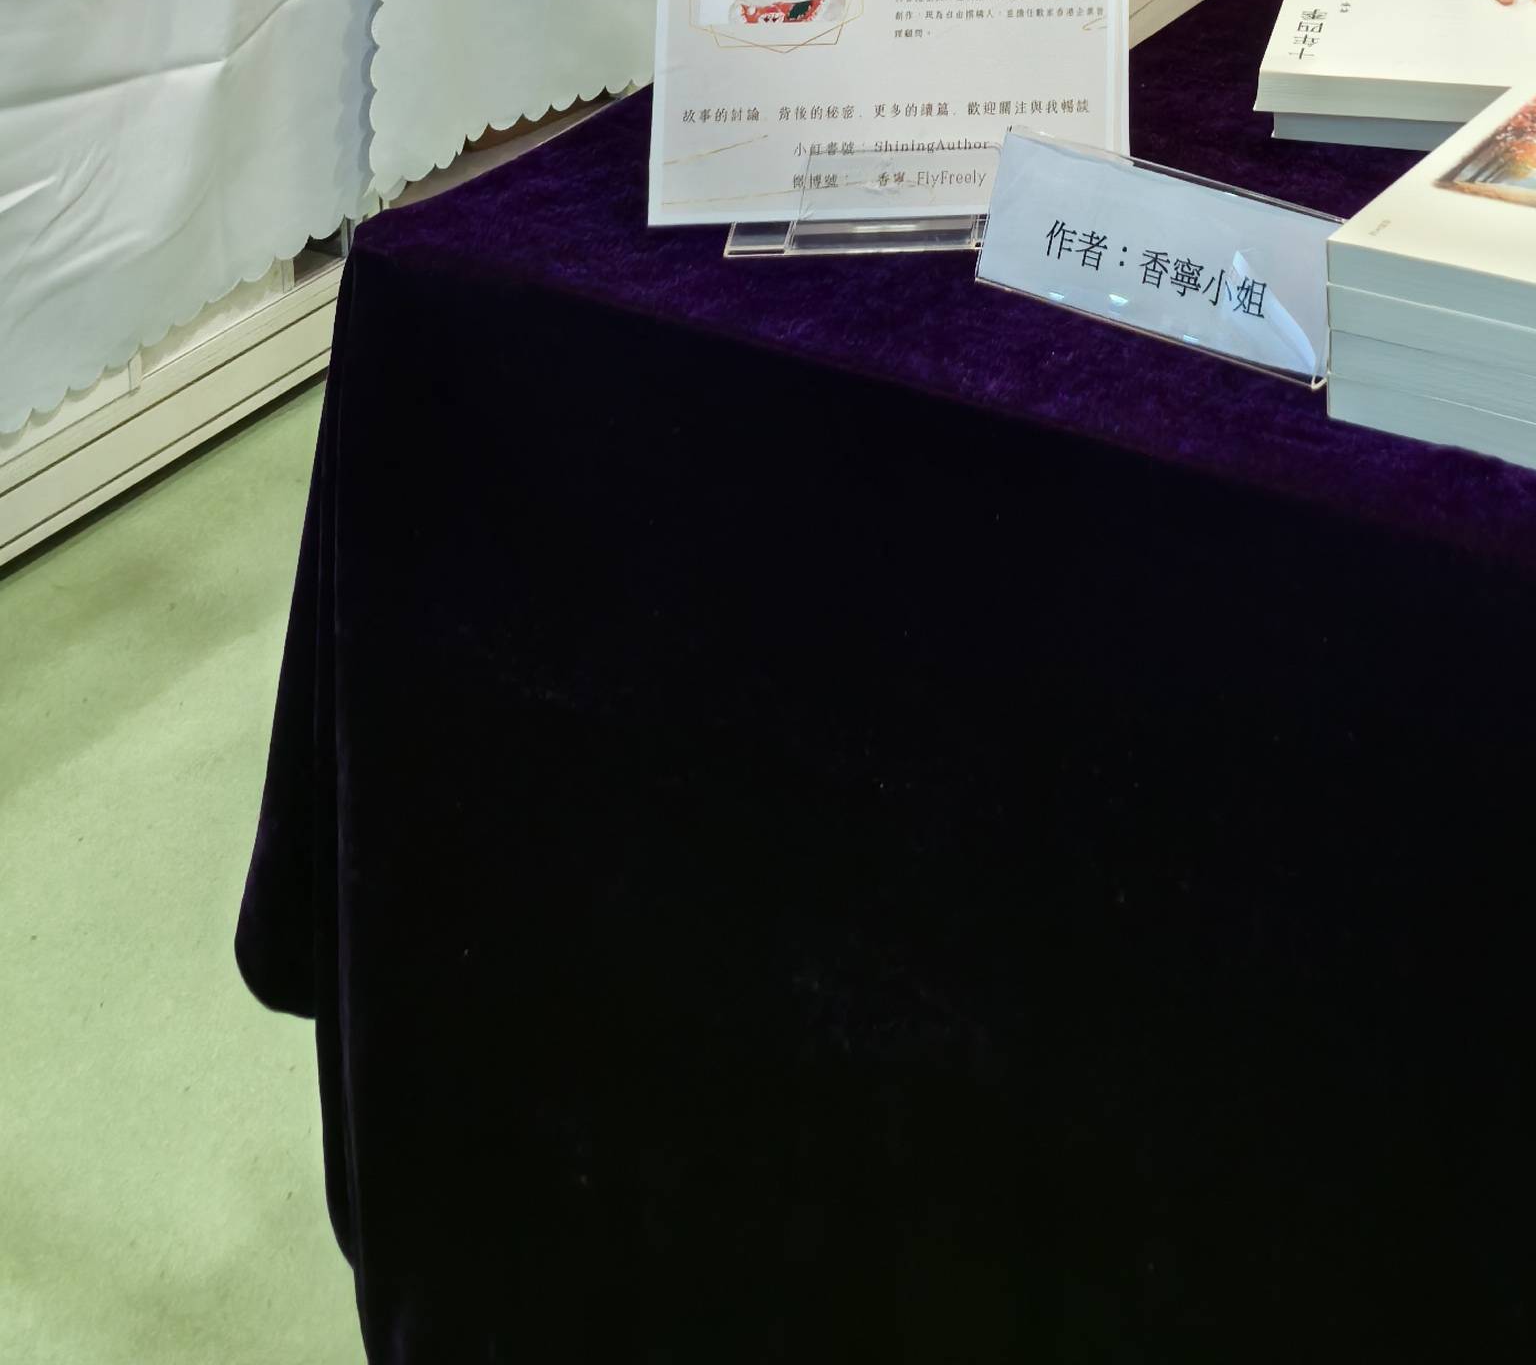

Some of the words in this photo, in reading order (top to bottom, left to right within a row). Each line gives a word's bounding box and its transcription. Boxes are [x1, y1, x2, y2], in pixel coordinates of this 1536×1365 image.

[1045, 219, 1268, 319] 作者：香寧小姐
